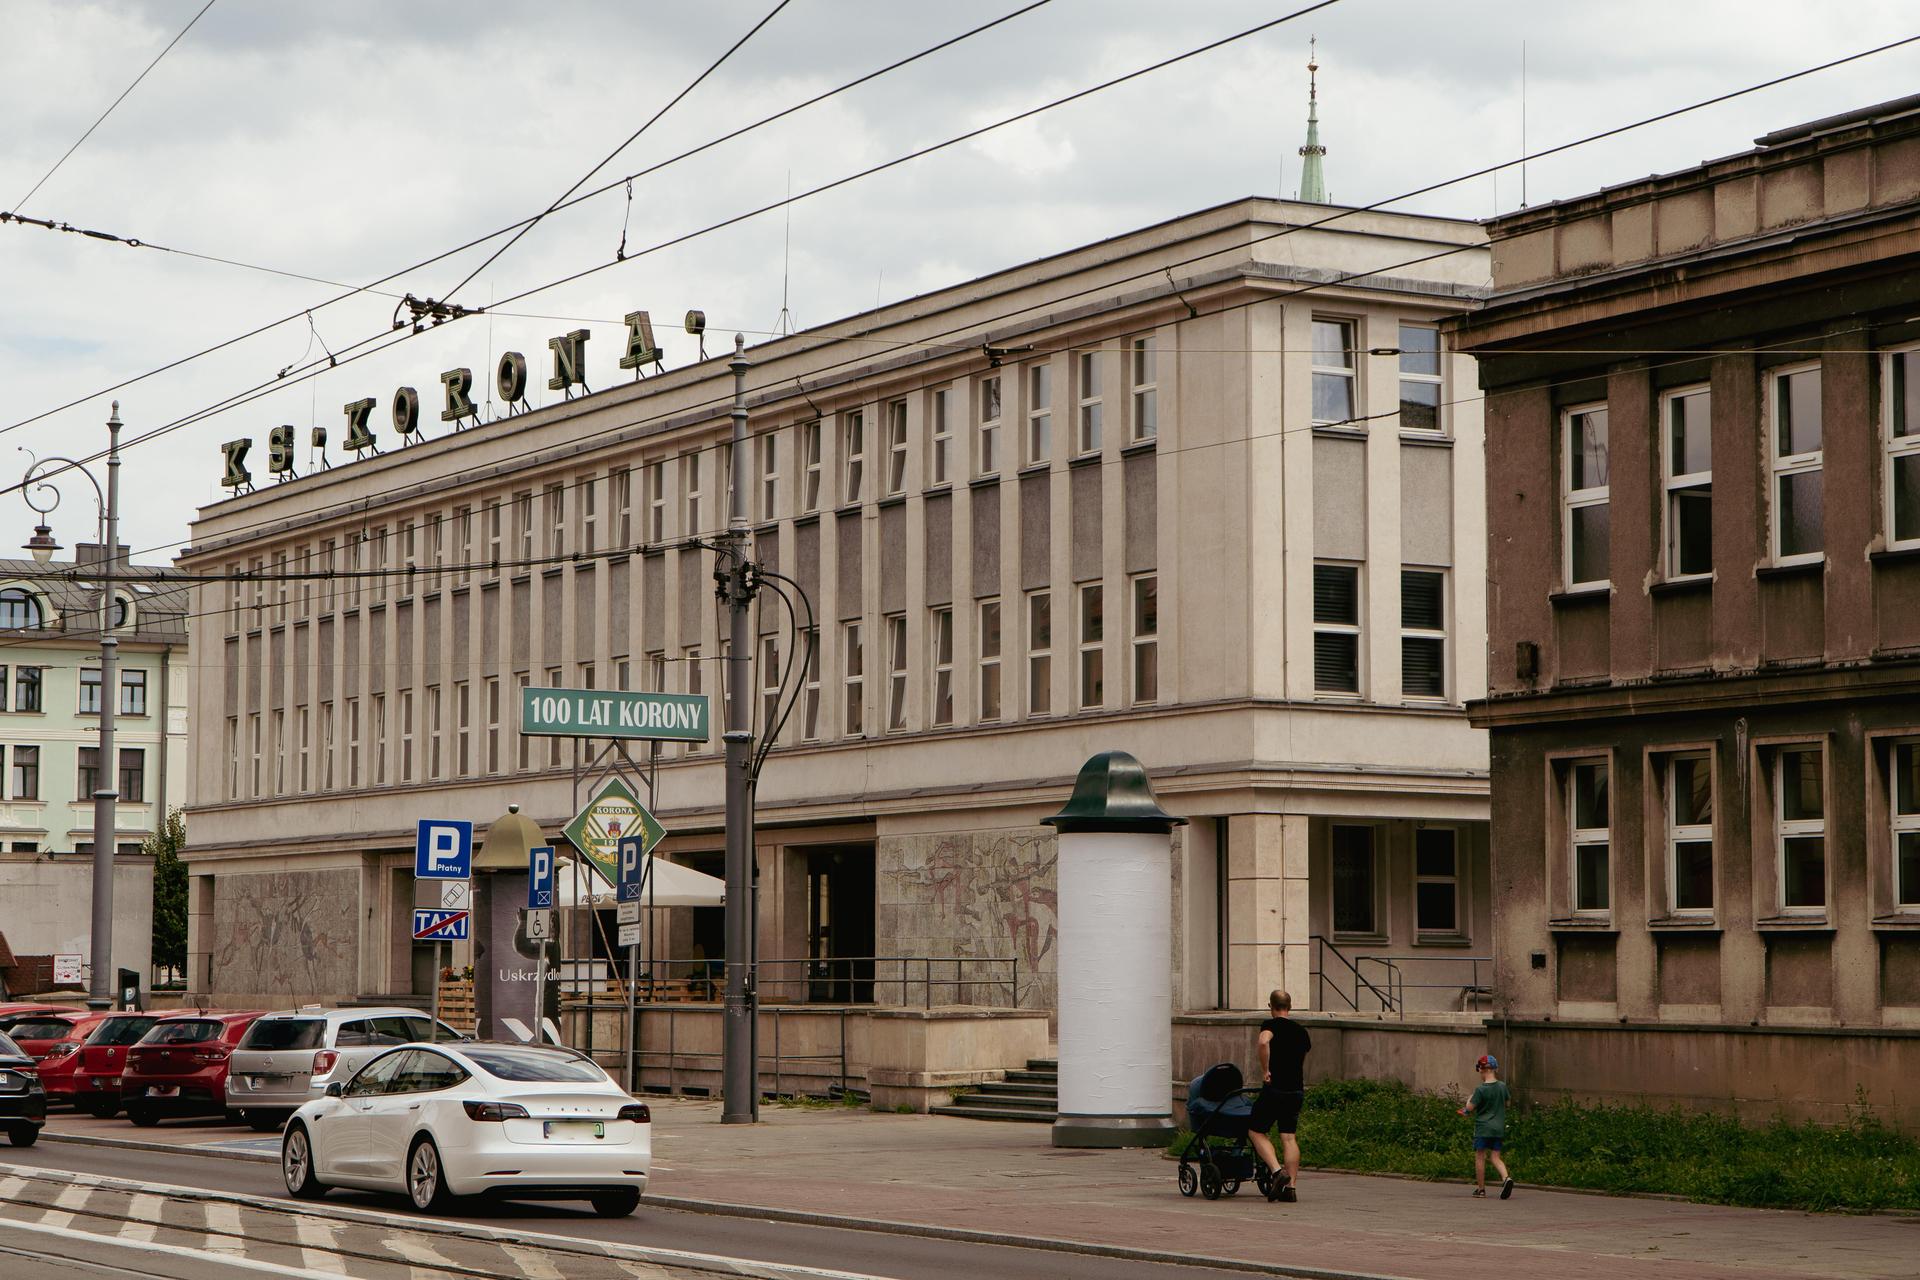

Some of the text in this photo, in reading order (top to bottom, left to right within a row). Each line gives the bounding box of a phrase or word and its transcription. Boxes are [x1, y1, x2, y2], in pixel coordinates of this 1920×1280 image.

[343, 309, 664, 451] KORONA
[531, 697, 701, 729] 100 LAT KORONY
[428, 826, 460, 871] P
[623, 843, 636, 882] P
[437, 864, 462, 874] Płatny
[534, 852, 549, 890] P
[416, 912, 466, 936] TAXI
